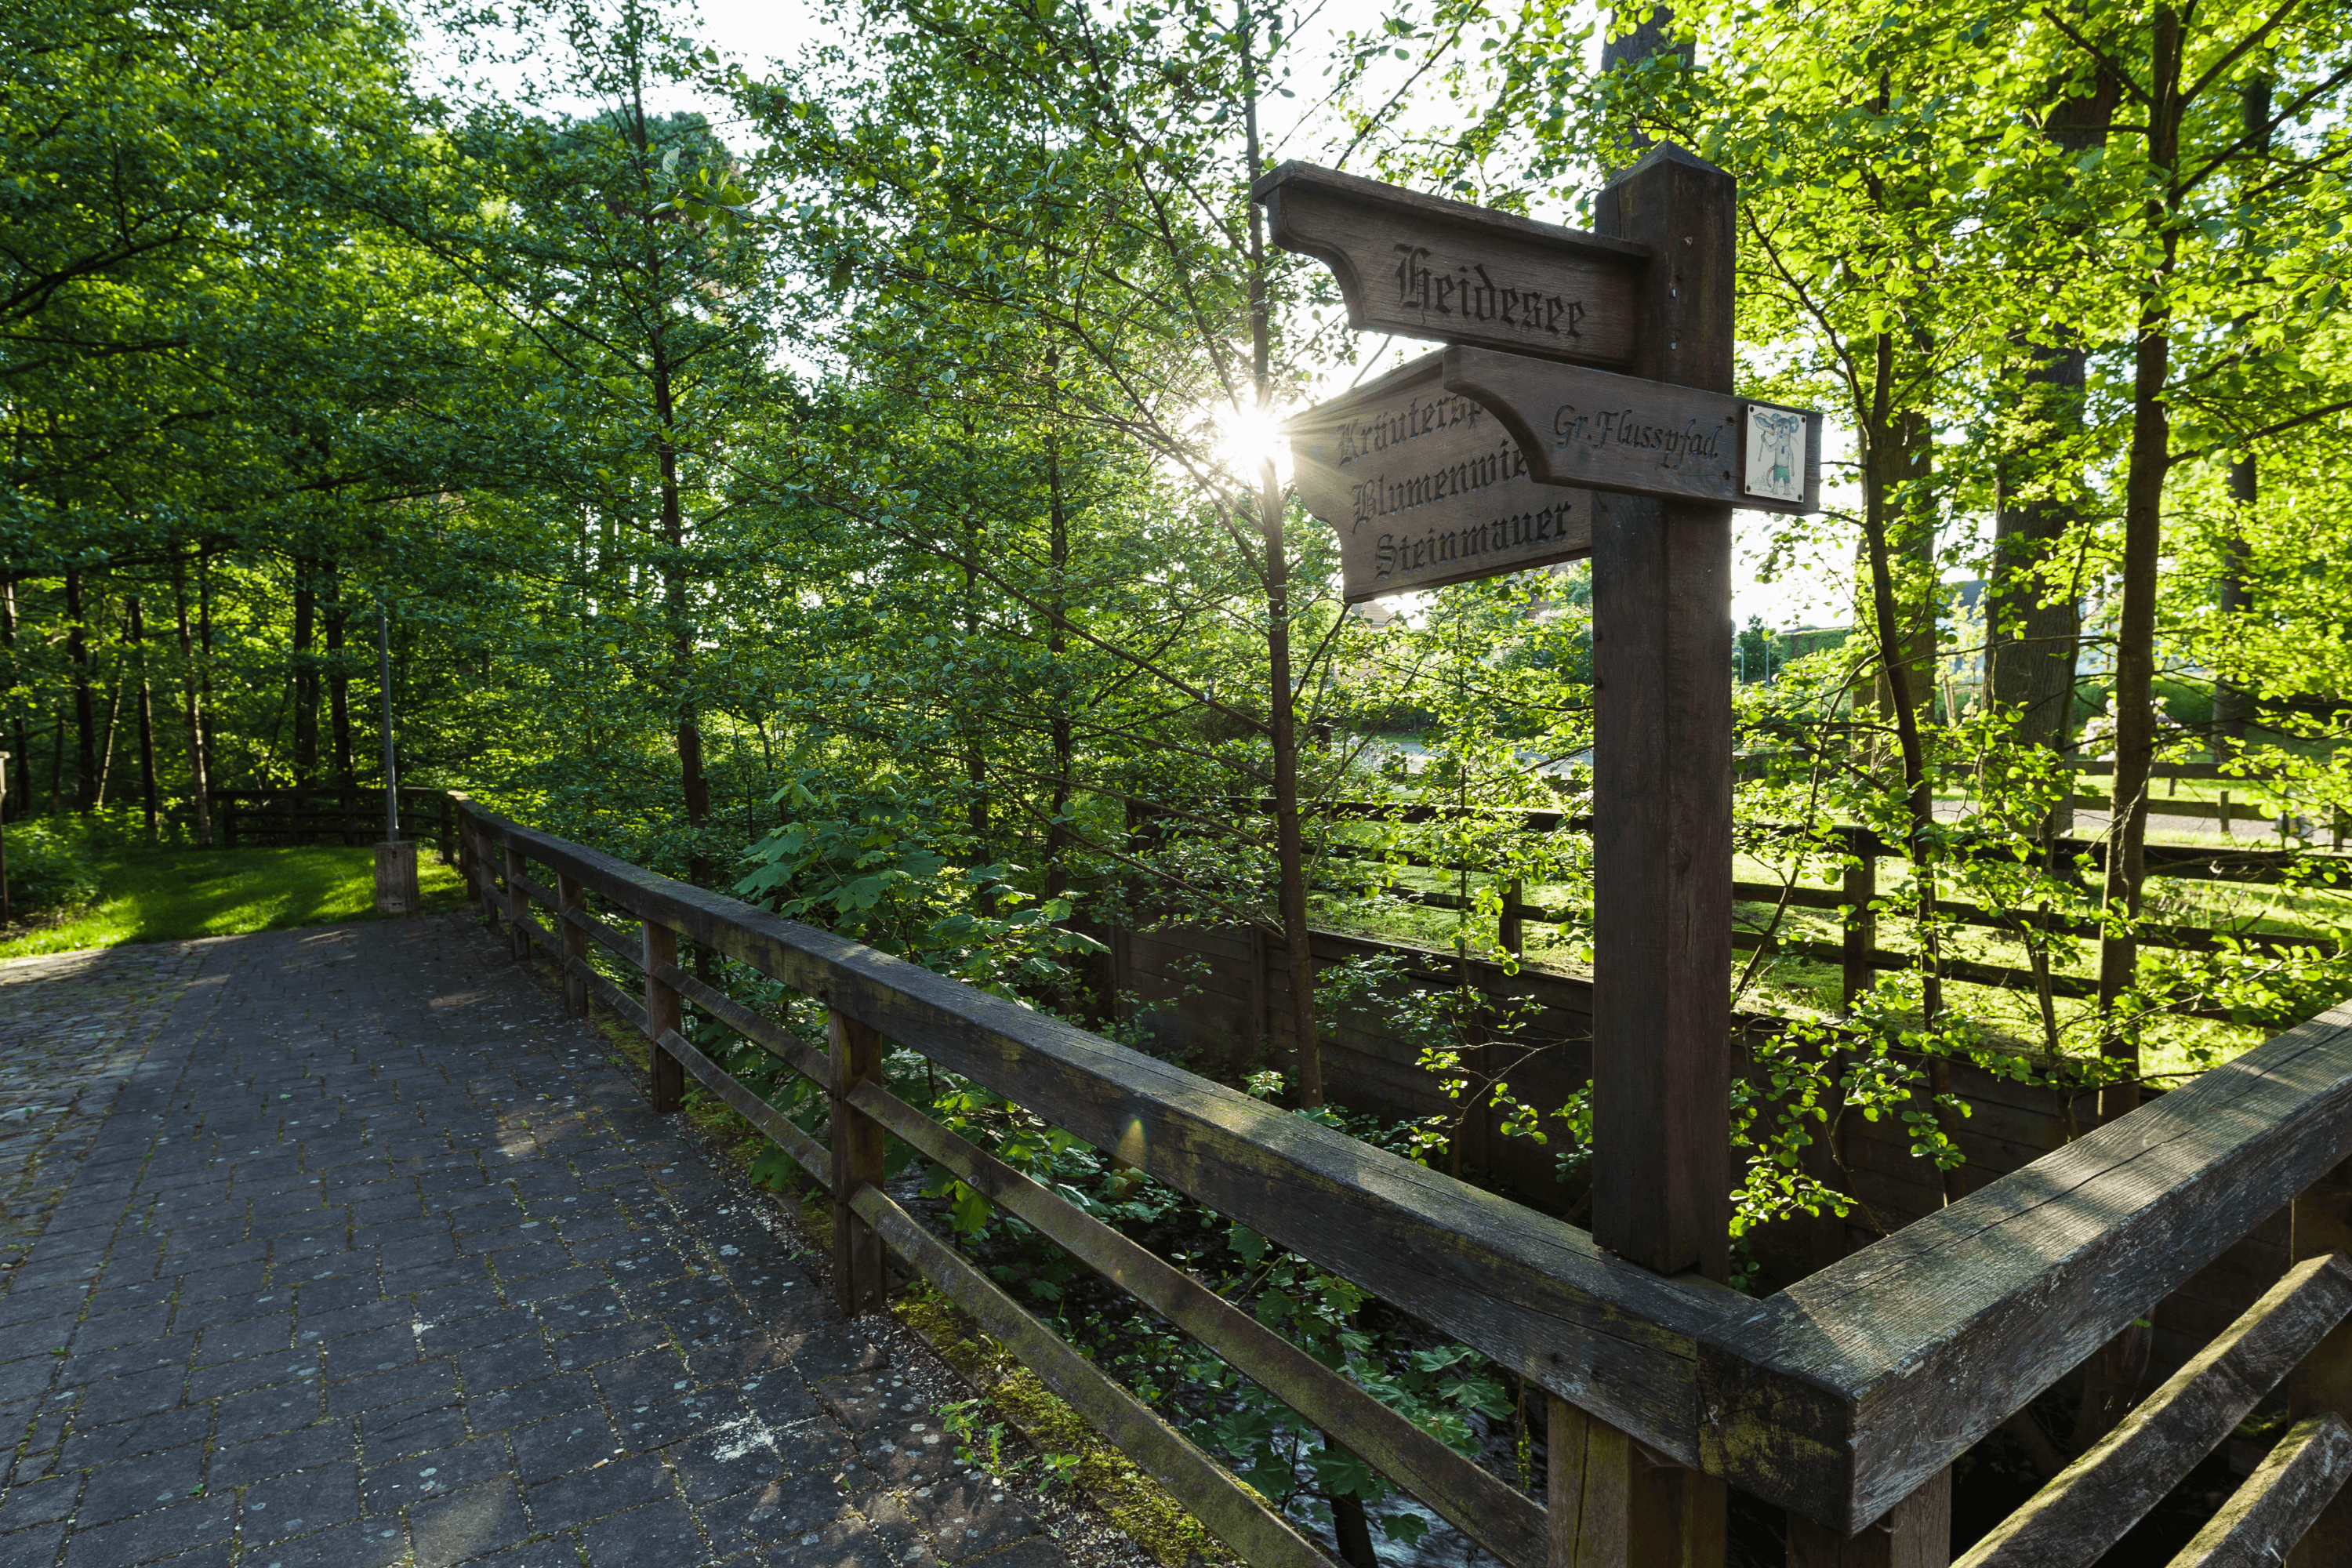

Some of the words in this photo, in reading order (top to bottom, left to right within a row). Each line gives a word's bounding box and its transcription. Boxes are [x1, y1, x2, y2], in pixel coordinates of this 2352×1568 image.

[1393, 243, 1586, 338] Heidesee
[1351, 439, 1528, 535] Blumenwie
[1374, 500, 1573, 580] Steinmauer
